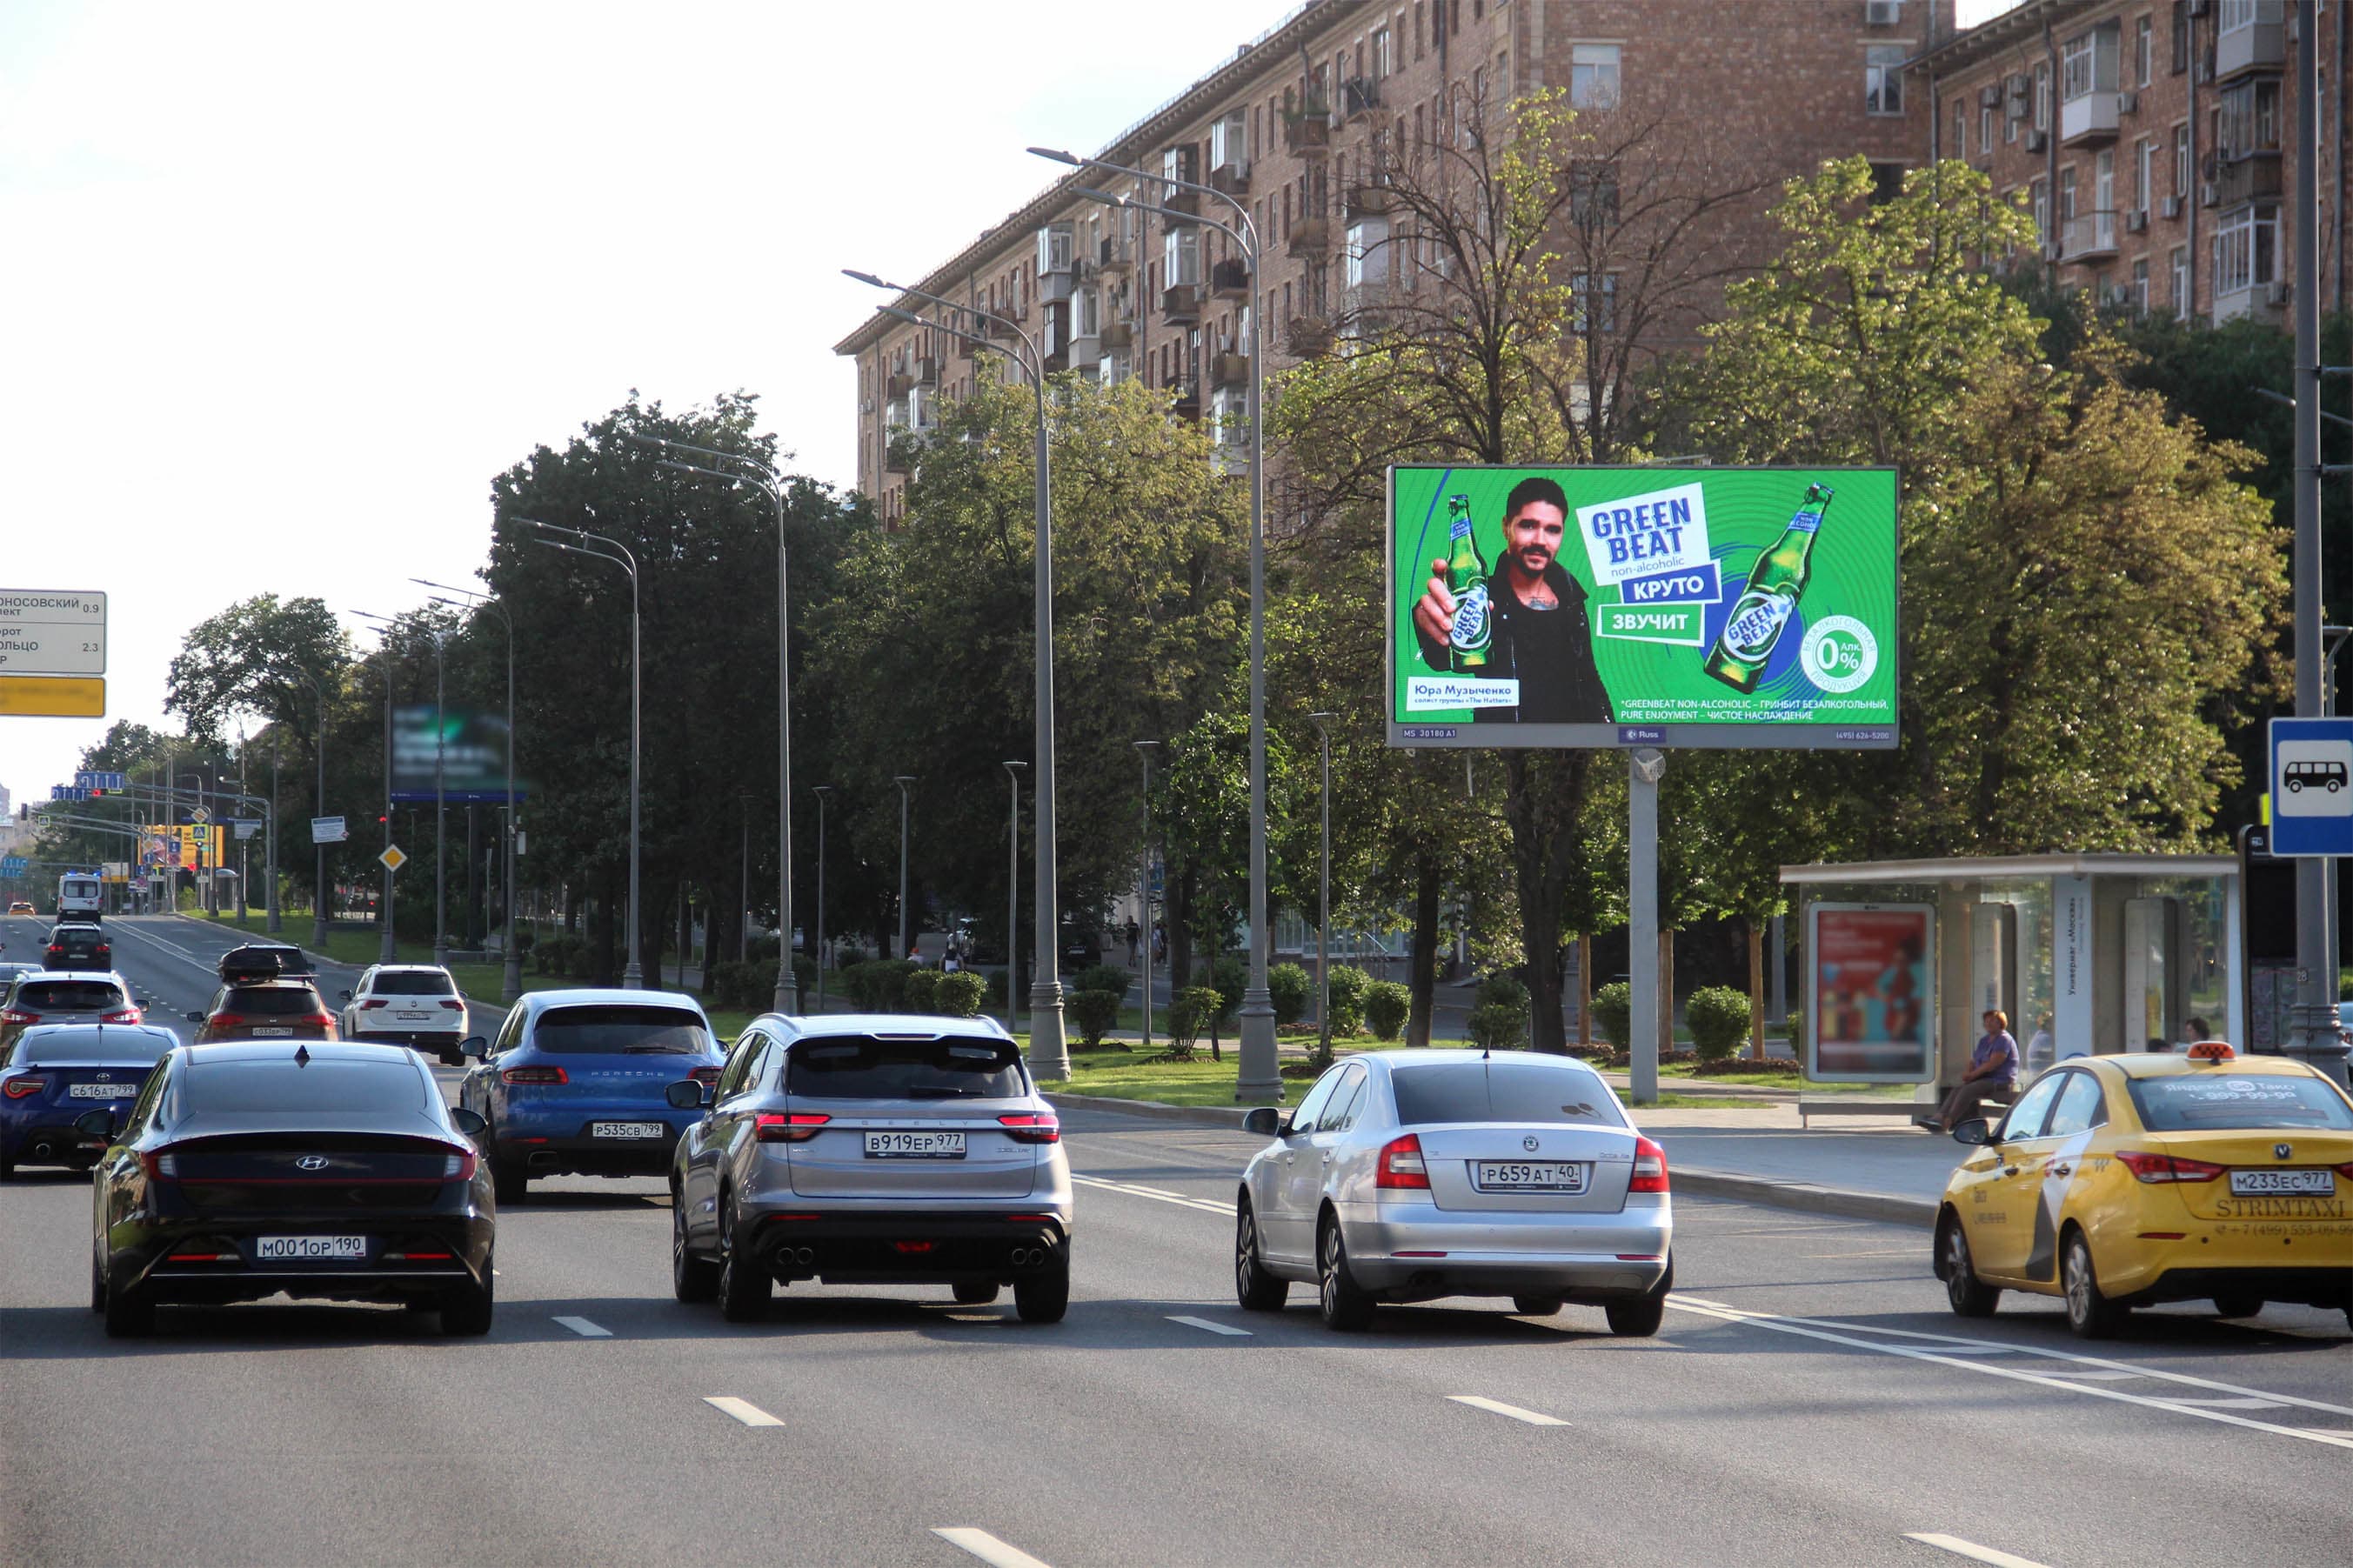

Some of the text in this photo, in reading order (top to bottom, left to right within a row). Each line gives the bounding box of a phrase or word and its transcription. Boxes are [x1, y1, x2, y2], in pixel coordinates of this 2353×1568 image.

[1592, 497, 1691, 538] GREEN
[1608, 526, 1684, 564] BEAT
[1611, 557, 1685, 577] non-alcoholic
[1634, 576, 1704, 600] КРУТО
[83, 604, 99, 613] 0.9
[1453, 598, 1478, 639] GREEN
[1464, 607, 1483, 637] BEAT
[1613, 614, 1688, 630] ЗВУЧИТ
[1728, 604, 1776, 640] GREEN
[0, 628, 22, 637] рот
[1741, 619, 1774, 646] BEAT
[83, 643, 98, 652] 2.3
[1415, 685, 1512, 697] Юра Музыченко
[1677, 699, 1752, 709] NON-ALCOHOLIC
[1761, 699, 1800, 709] ГРИНБИТ
[1802, 698, 1888, 710] БЕЗАЛКОГОЛЬНЫЙ,
[1621, 711, 1643, 719] PURE
[1646, 711, 1698, 719] ENJOYMENT
[1708, 711, 1743, 719] ЧИСТОЕ
[1745, 711, 1813, 721] НАСЛАЖДЕНИЕ
[937, 1134, 960, 1146] 977
[1559, 1165, 1574, 1178] 40
[2303, 1172, 2328, 1184] 977
[2216, 1198, 2346, 1218] STRIMTAXI
[336, 1238, 361, 1251] 190
